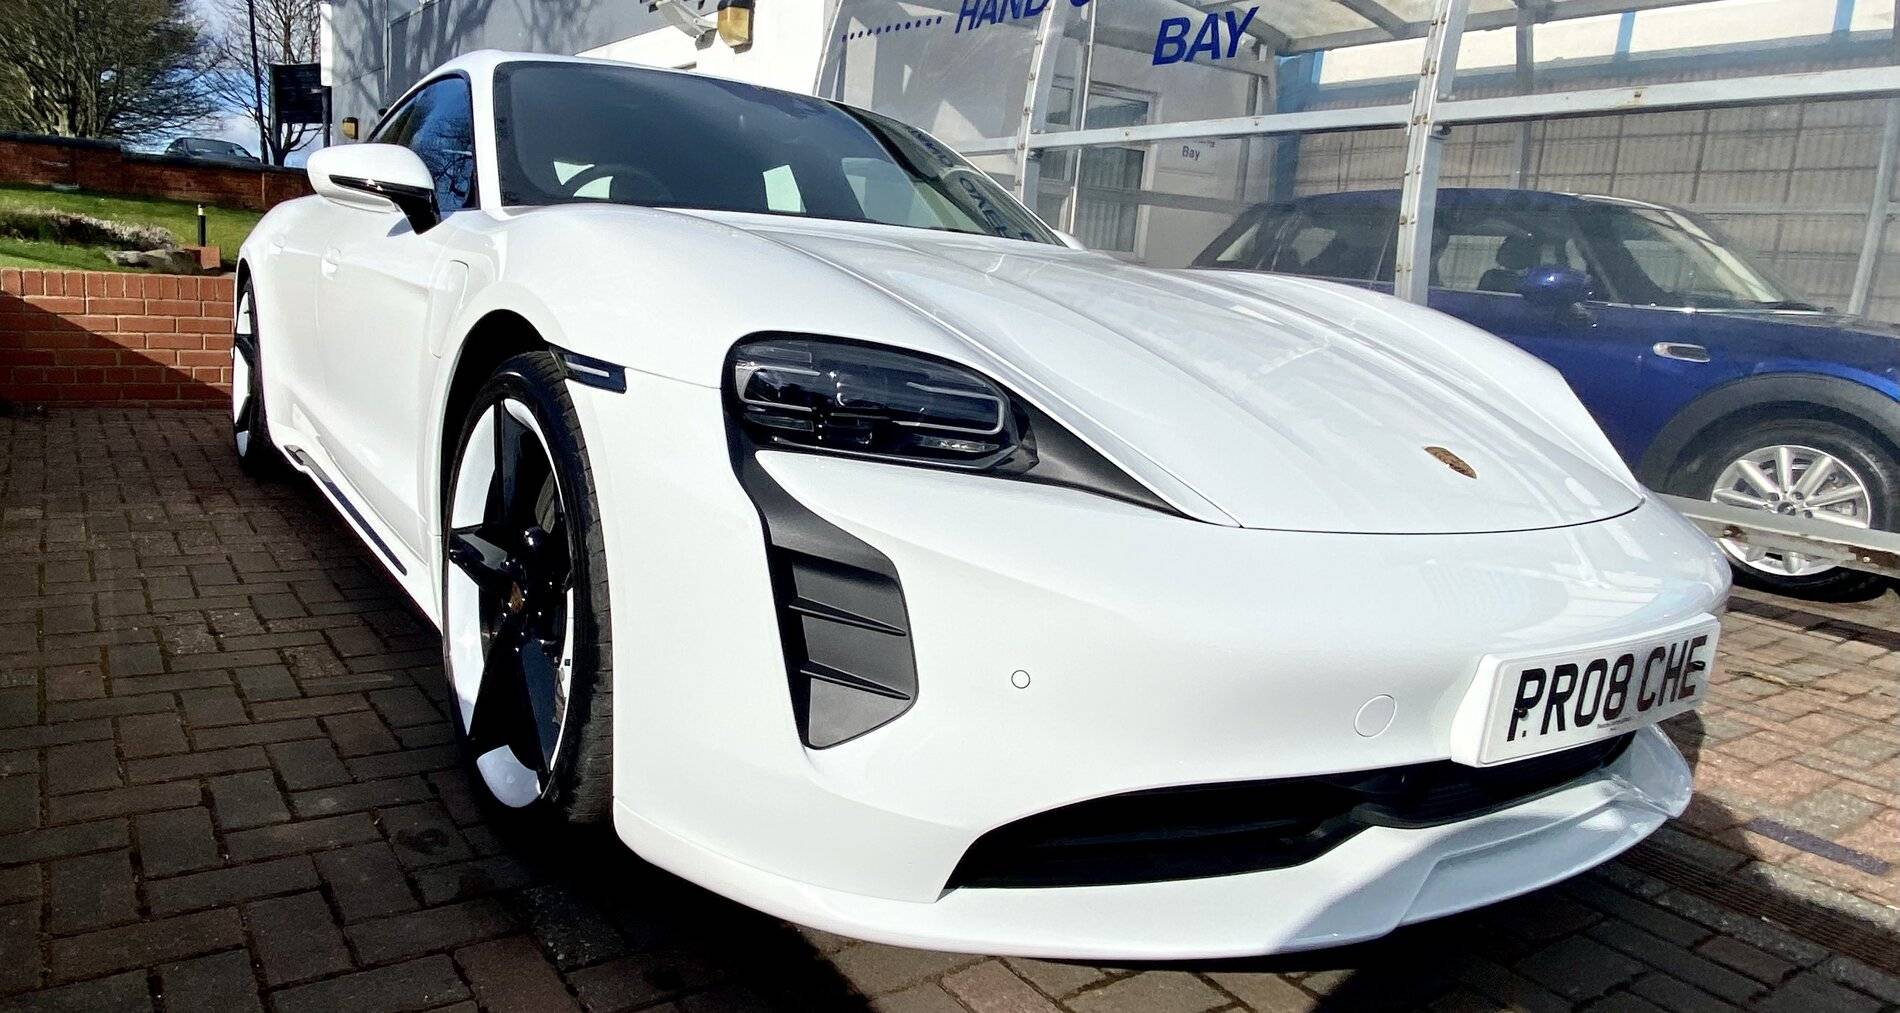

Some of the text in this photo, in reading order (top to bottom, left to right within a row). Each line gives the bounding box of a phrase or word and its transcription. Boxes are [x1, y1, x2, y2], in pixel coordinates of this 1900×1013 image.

[1152, 6, 1259, 66] BAY
[1182, 145, 1200, 161] Bay
[1637, 635, 1708, 712] CHE
